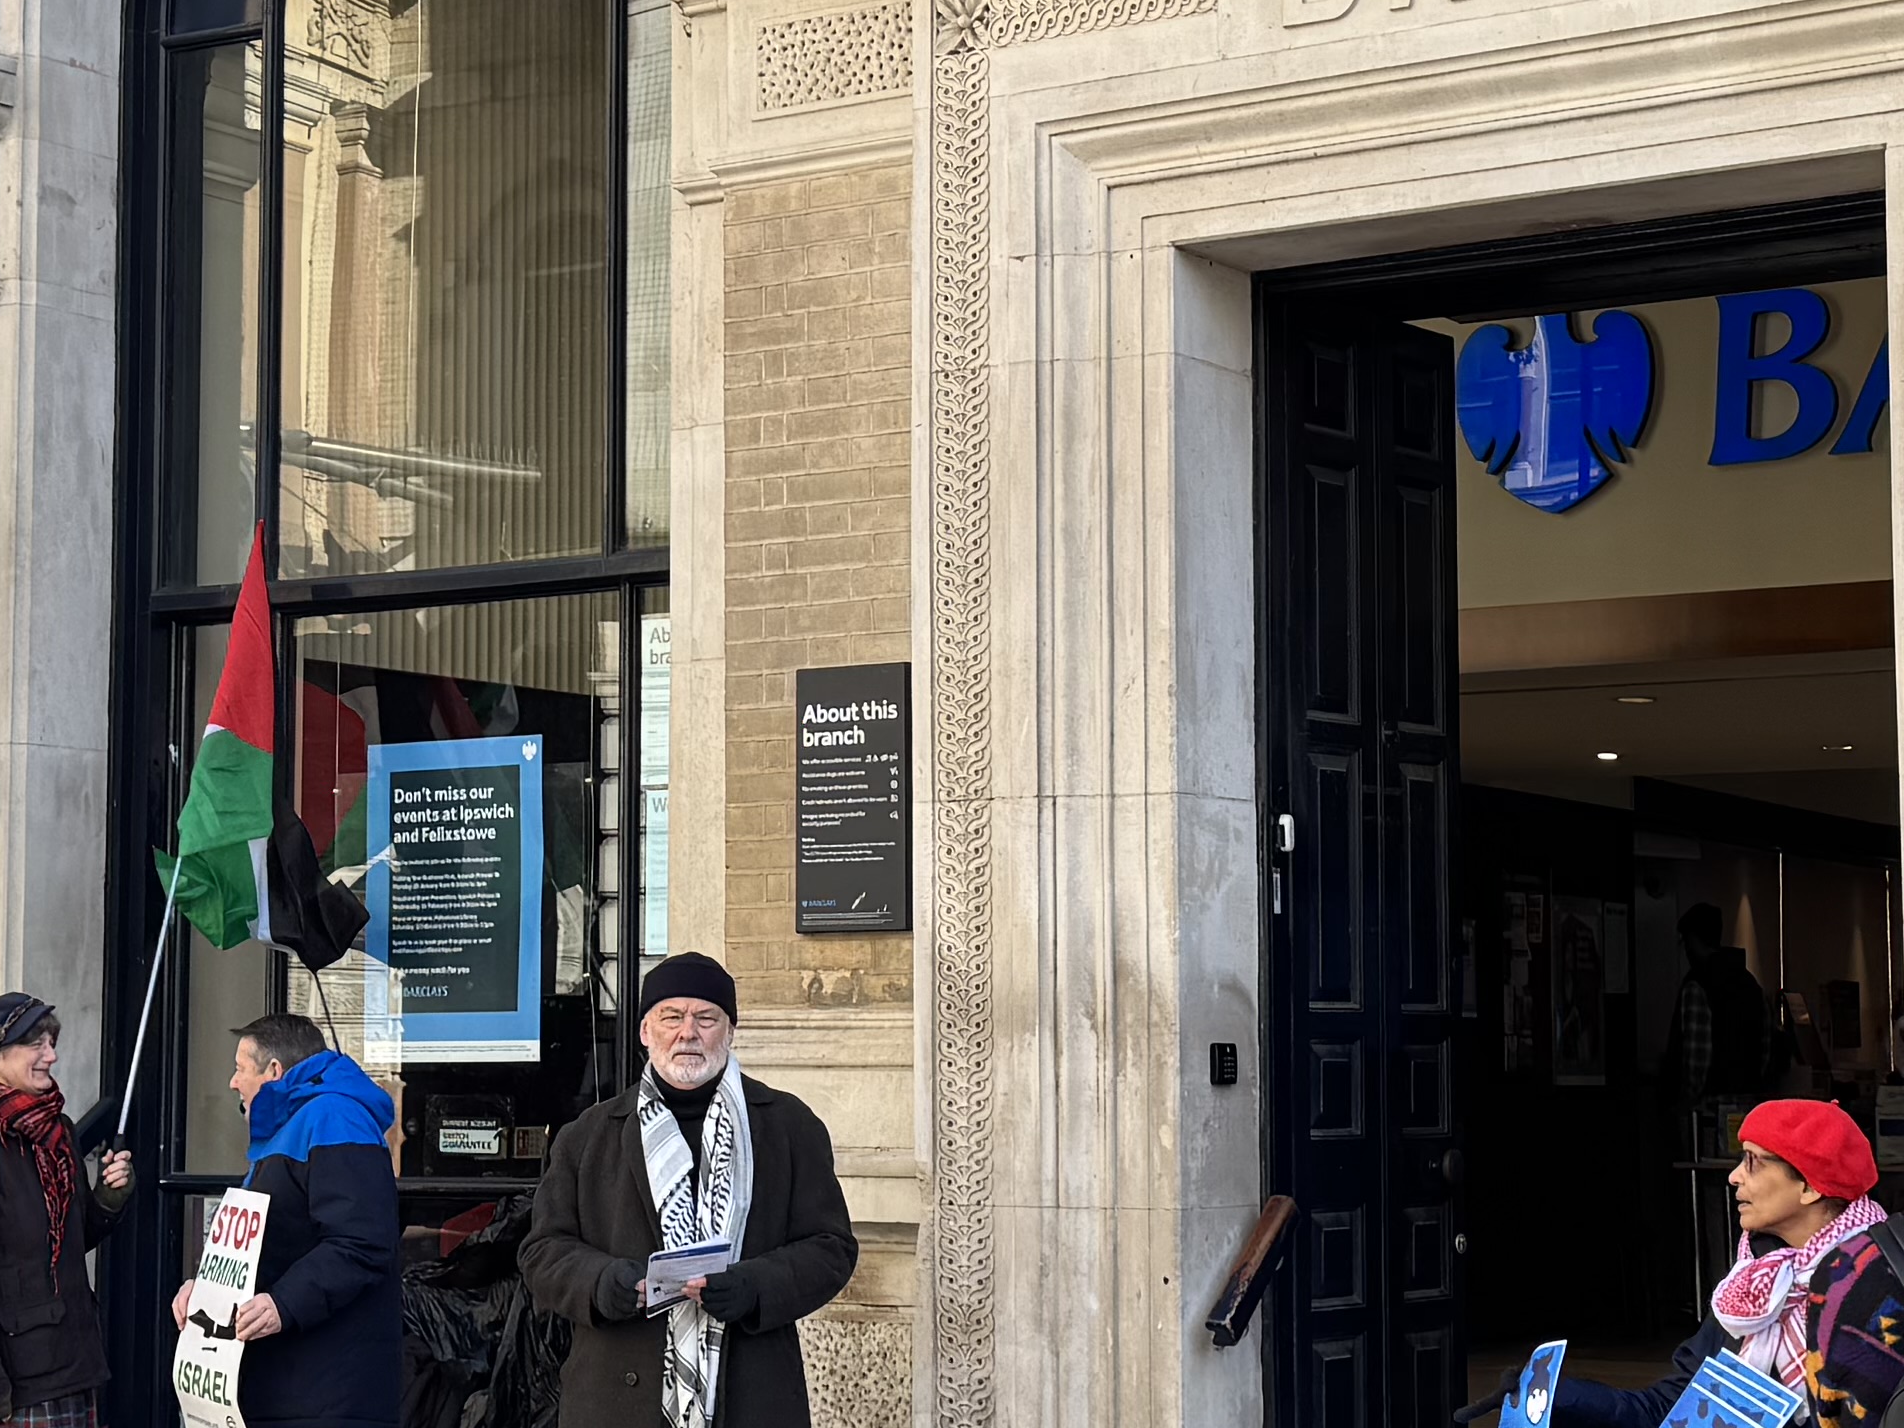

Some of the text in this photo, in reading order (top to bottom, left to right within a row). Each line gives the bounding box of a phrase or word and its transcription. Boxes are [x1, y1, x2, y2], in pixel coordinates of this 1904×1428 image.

[802, 700, 898, 724] About this
[802, 725, 865, 747] branch
[394, 786, 495, 804] Don't miss our
[652, 797, 669, 814] W
[393, 803, 514, 825] events at Ipswich
[393, 826, 497, 844] and Felixstowe
[211, 1204, 261, 1252] STOP
[197, 1253, 250, 1291] ARMING
[177, 1359, 232, 1407] ISRAEL
